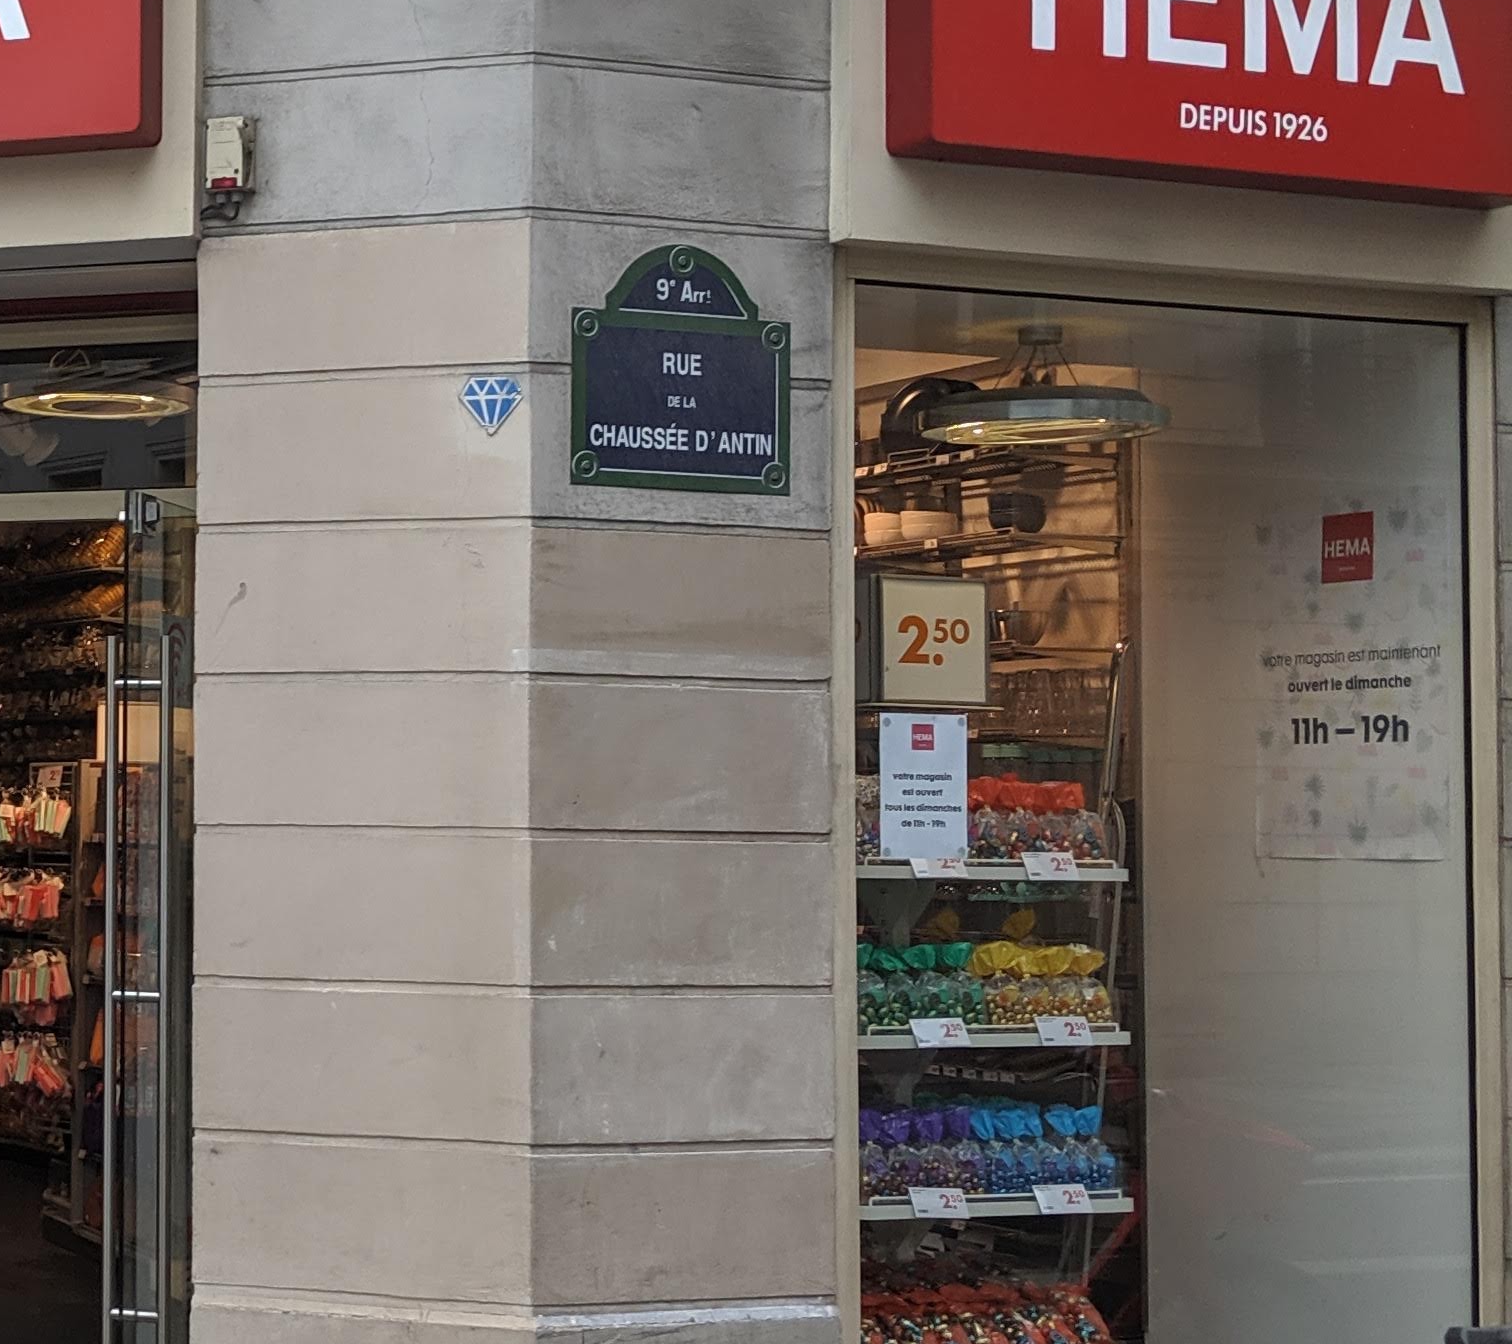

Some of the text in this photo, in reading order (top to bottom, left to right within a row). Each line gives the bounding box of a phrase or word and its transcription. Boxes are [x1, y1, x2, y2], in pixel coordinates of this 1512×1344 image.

[1180, 102, 1328, 142] DEPUIS 1926
[662, 352, 702, 376] RUE
[667, 395, 696, 408] DE LA
[590, 423, 688, 451] CHAUSSÉE
[1324, 537, 1371, 558] HEMA
[1263, 644, 1441, 668] votre magasin est maintenant
[1288, 674, 1411, 693] ouvert le dimanche
[1291, 717, 1329, 744] 11h
[1361, 714, 1409, 743] 19h
[915, 788, 943, 796] ouvert
[916, 803, 962, 812] dimanches
